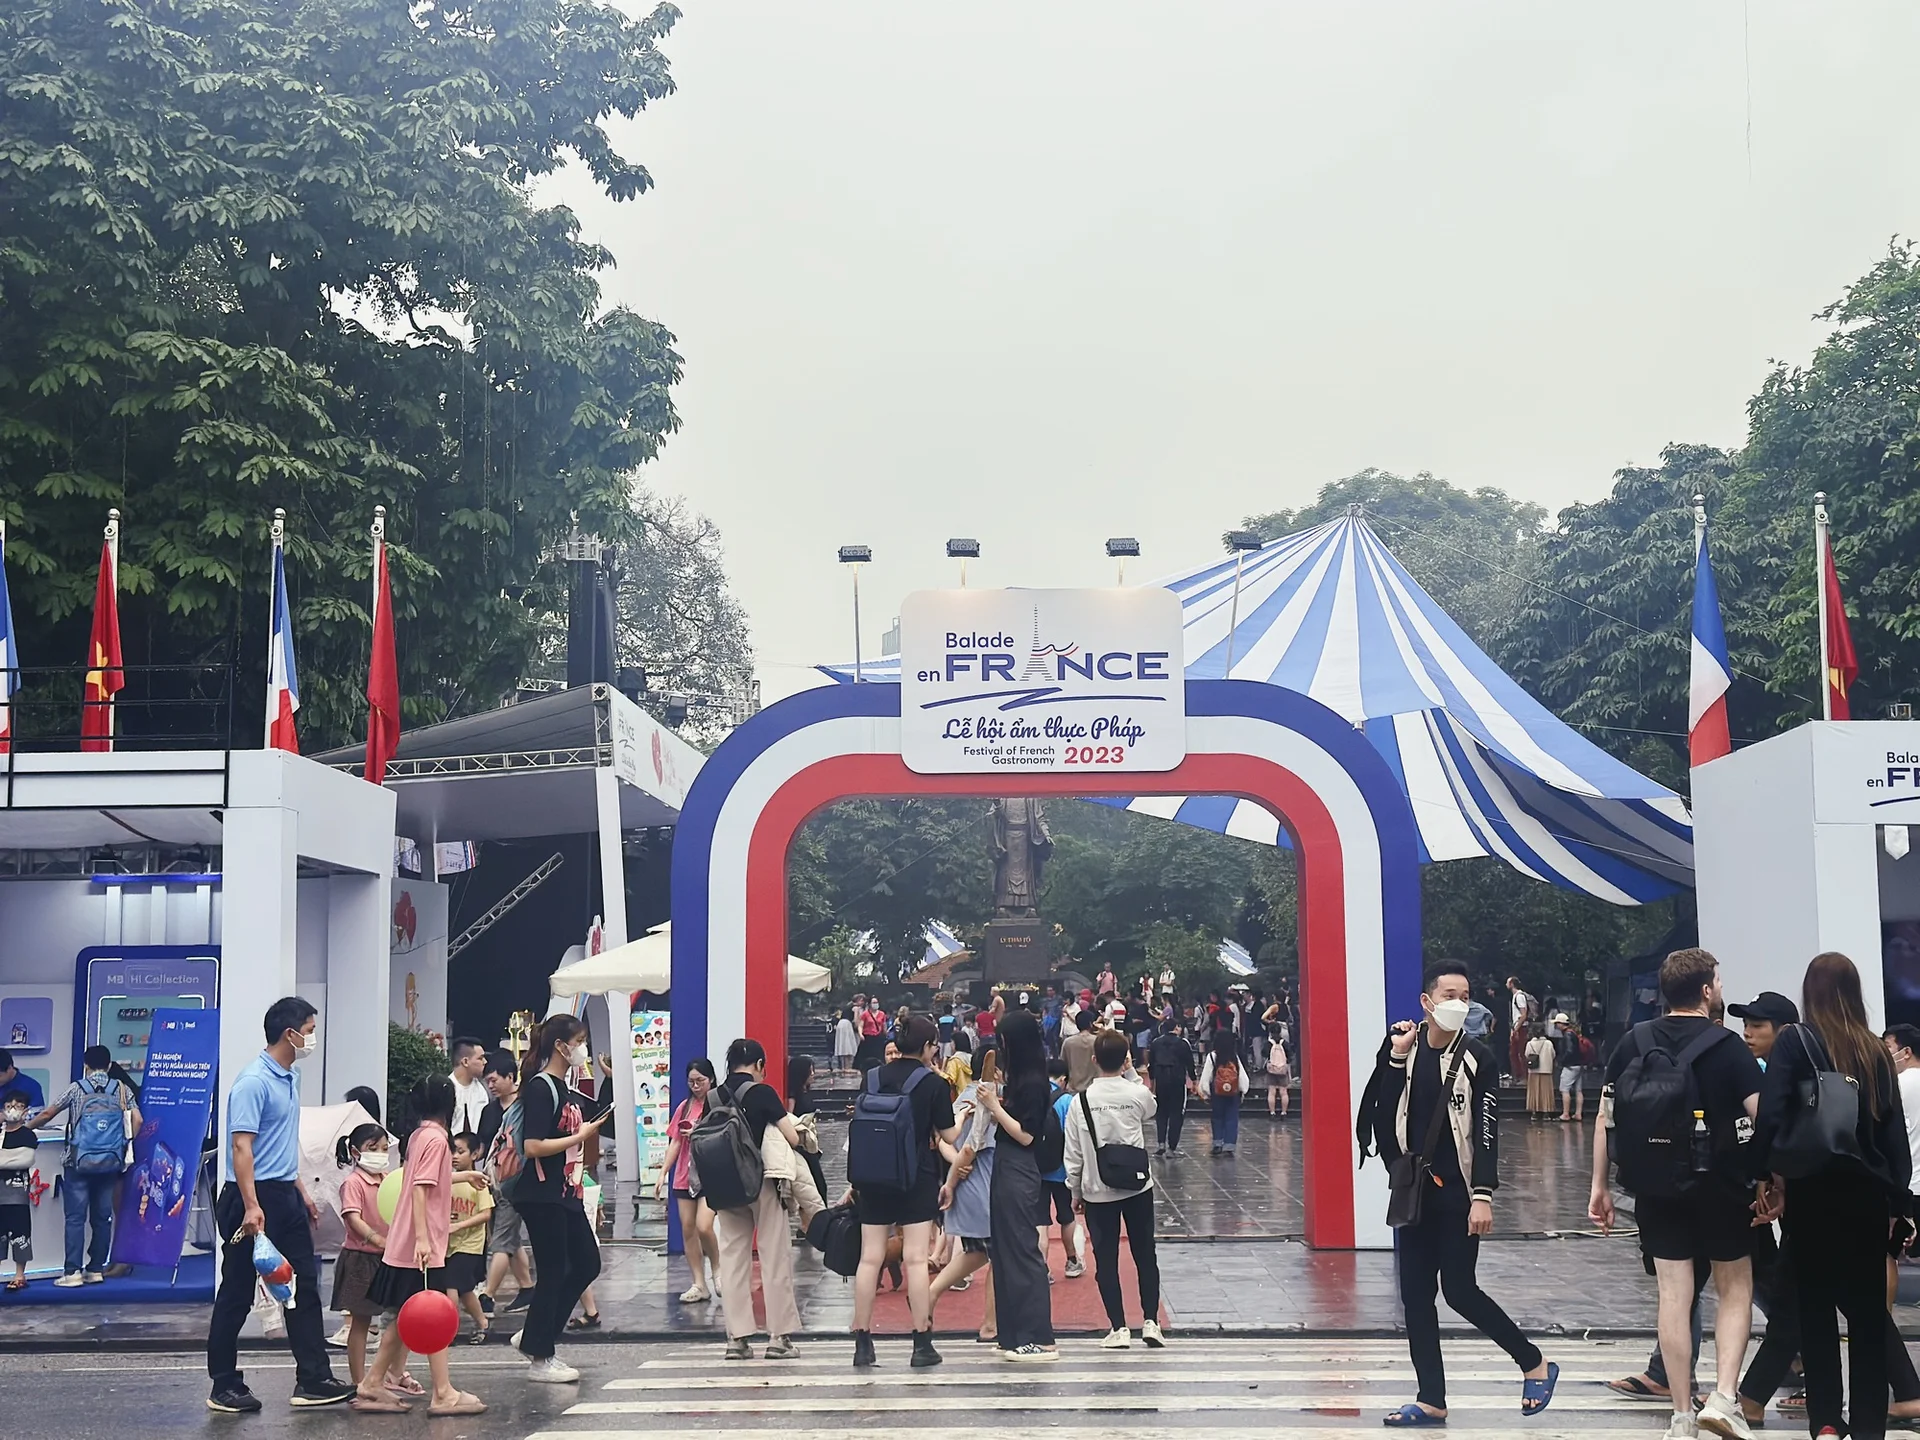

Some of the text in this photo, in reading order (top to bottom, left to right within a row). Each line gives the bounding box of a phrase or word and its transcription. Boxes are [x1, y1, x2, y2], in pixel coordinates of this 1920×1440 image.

[946, 631, 1015, 648] Balade
[917, 651, 1169, 682] en FRANCE
[942, 714, 1146, 748] Lễ hội ẩm thực Pháp
[963, 745, 1055, 756] Festival of French
[1063, 746, 1125, 764] 2023
[991, 755, 1055, 766] Gastronomy
[1866, 767, 1920, 788] en F
[107, 975, 124, 984] MB
[144, 973, 200, 984] Collection
